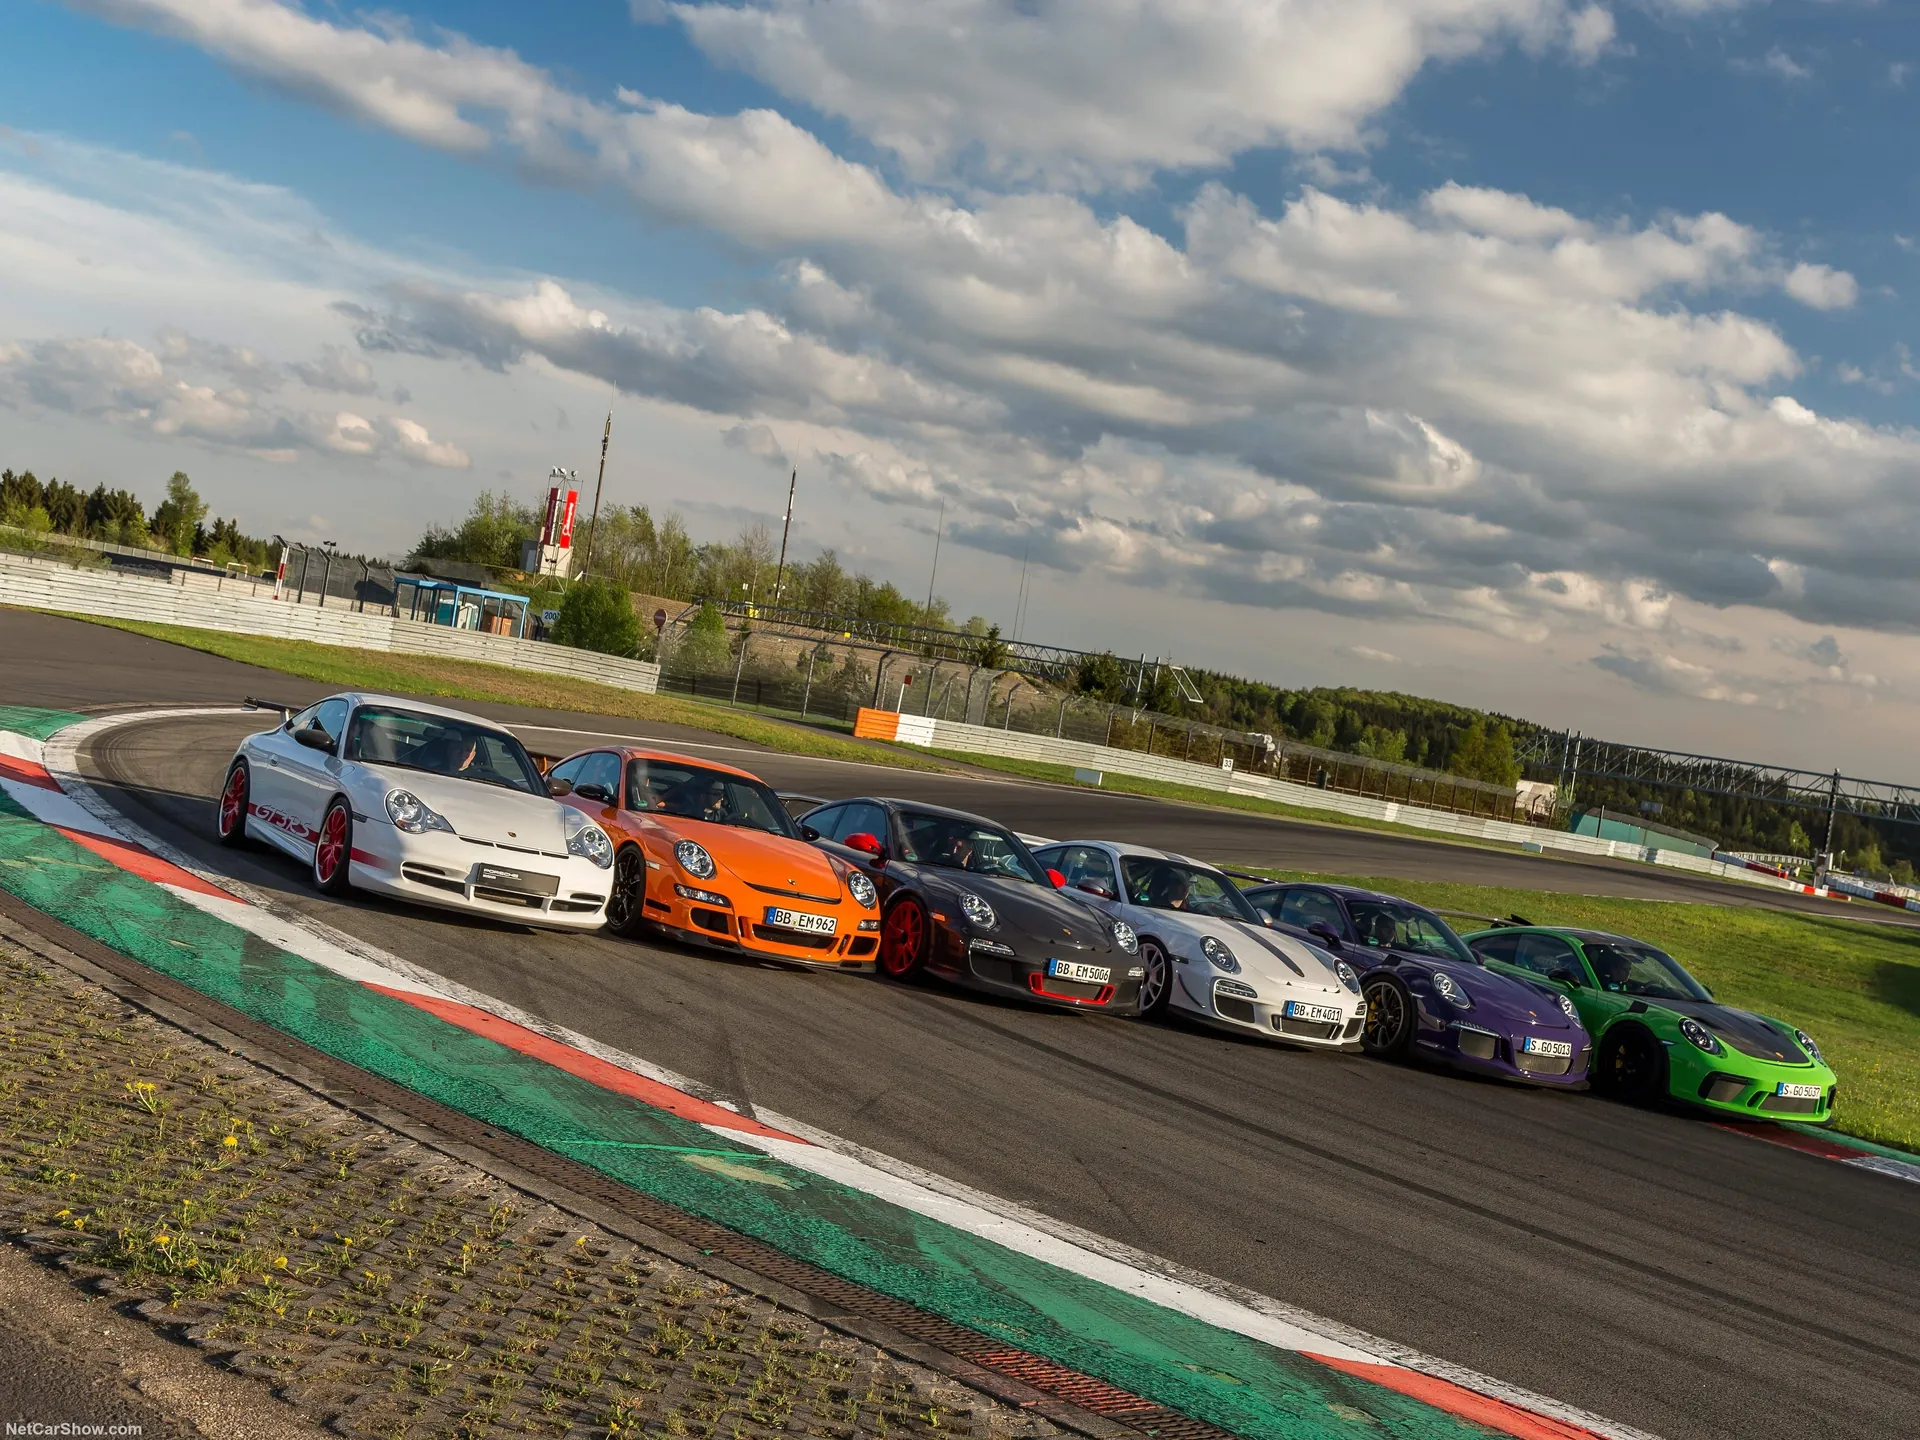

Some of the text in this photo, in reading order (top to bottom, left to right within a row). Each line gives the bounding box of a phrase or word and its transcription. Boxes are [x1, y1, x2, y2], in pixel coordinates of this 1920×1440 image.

[775, 911, 791, 924] BB
[1057, 962, 1070, 975] BB
[1294, 1004, 1306, 1016] BB
[1531, 1040, 1537, 1051] S
[1784, 1085, 1789, 1095] S
